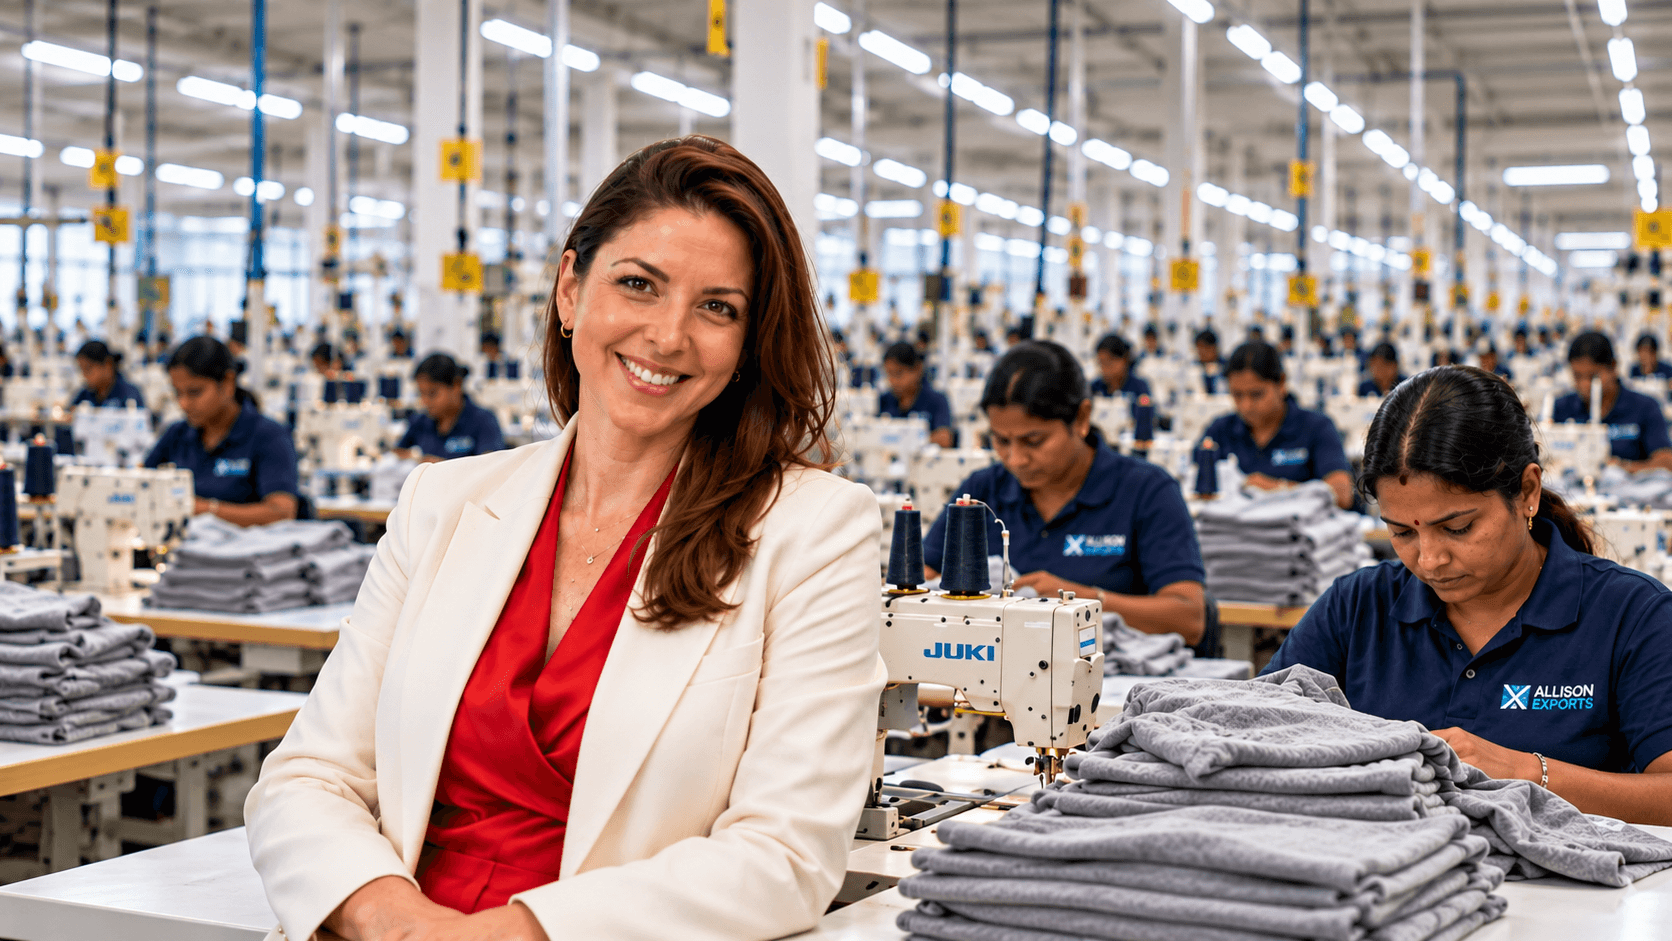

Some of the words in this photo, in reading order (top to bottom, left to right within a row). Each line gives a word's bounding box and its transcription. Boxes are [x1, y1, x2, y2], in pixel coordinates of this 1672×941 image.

[923, 642, 995, 661] JUKI
[1533, 683, 1594, 698] ALLISON
[1531, 697, 1594, 710] EXPORTS
